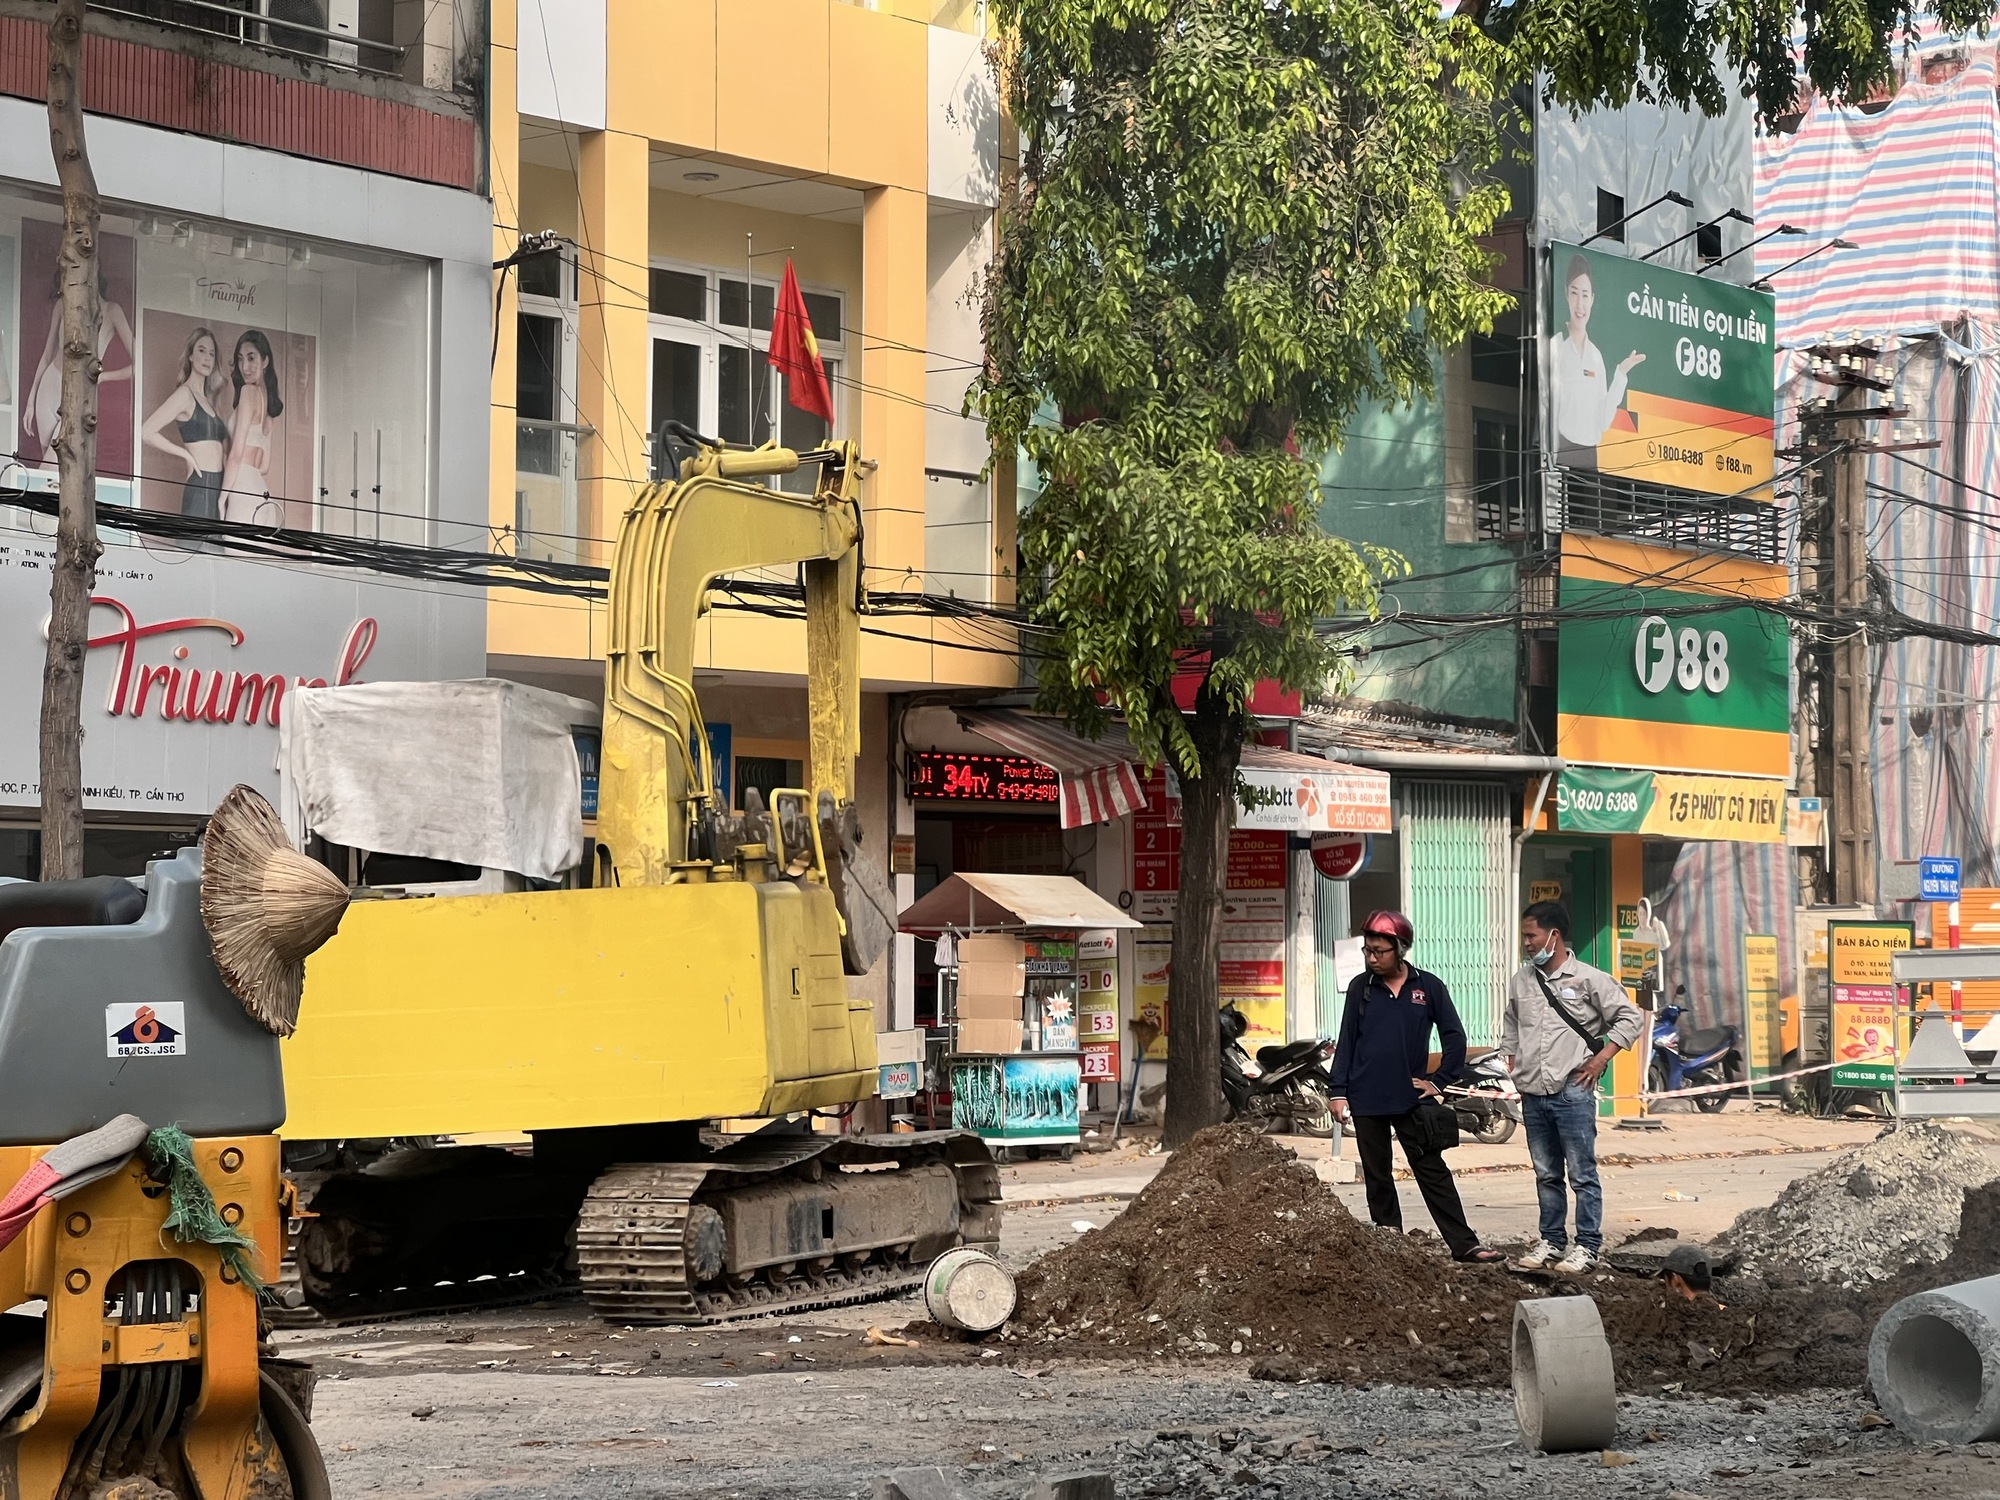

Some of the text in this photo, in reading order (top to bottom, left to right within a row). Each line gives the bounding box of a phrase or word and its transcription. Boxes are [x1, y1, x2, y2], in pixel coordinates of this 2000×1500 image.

[196, 276, 256, 311] Triumph
[1627, 283, 1766, 345] CẦN TIỀN GỌI LIỀN
[1676, 336, 1722, 380] F88
[1658, 444, 1704, 466] 1800 6388
[1726, 456, 1753, 475] f88.vn
[1635, 615, 1730, 693] F88
[1003, 764, 1032, 778] Power
[129, 789, 142, 800] TP.
[166, 791, 185, 802] THƠ
[1570, 788, 1638, 812] 1800 6388
[1669, 789, 1778, 825] 15 PHÚT CÓ TIỀN
[1334, 805, 1386, 829] XỔ SỐ TỰ CHỌN
[1146, 832, 1155, 849] 2
[1931, 862, 1955, 874] ĐƯỜNG
[1146, 870, 1156, 888] 3
[1531, 886, 1540, 900] 15
[1620, 909, 1638, 926] 78B
[1836, 934, 1907, 948] BÁN BẢO HIỂM
[1080, 973, 1112, 990] 3 0
[1412, 992, 1425, 1000] PT
[1080, 1003, 1107, 1011] JACKPOT
[1083, 1045, 1110, 1053] JACKPOT
